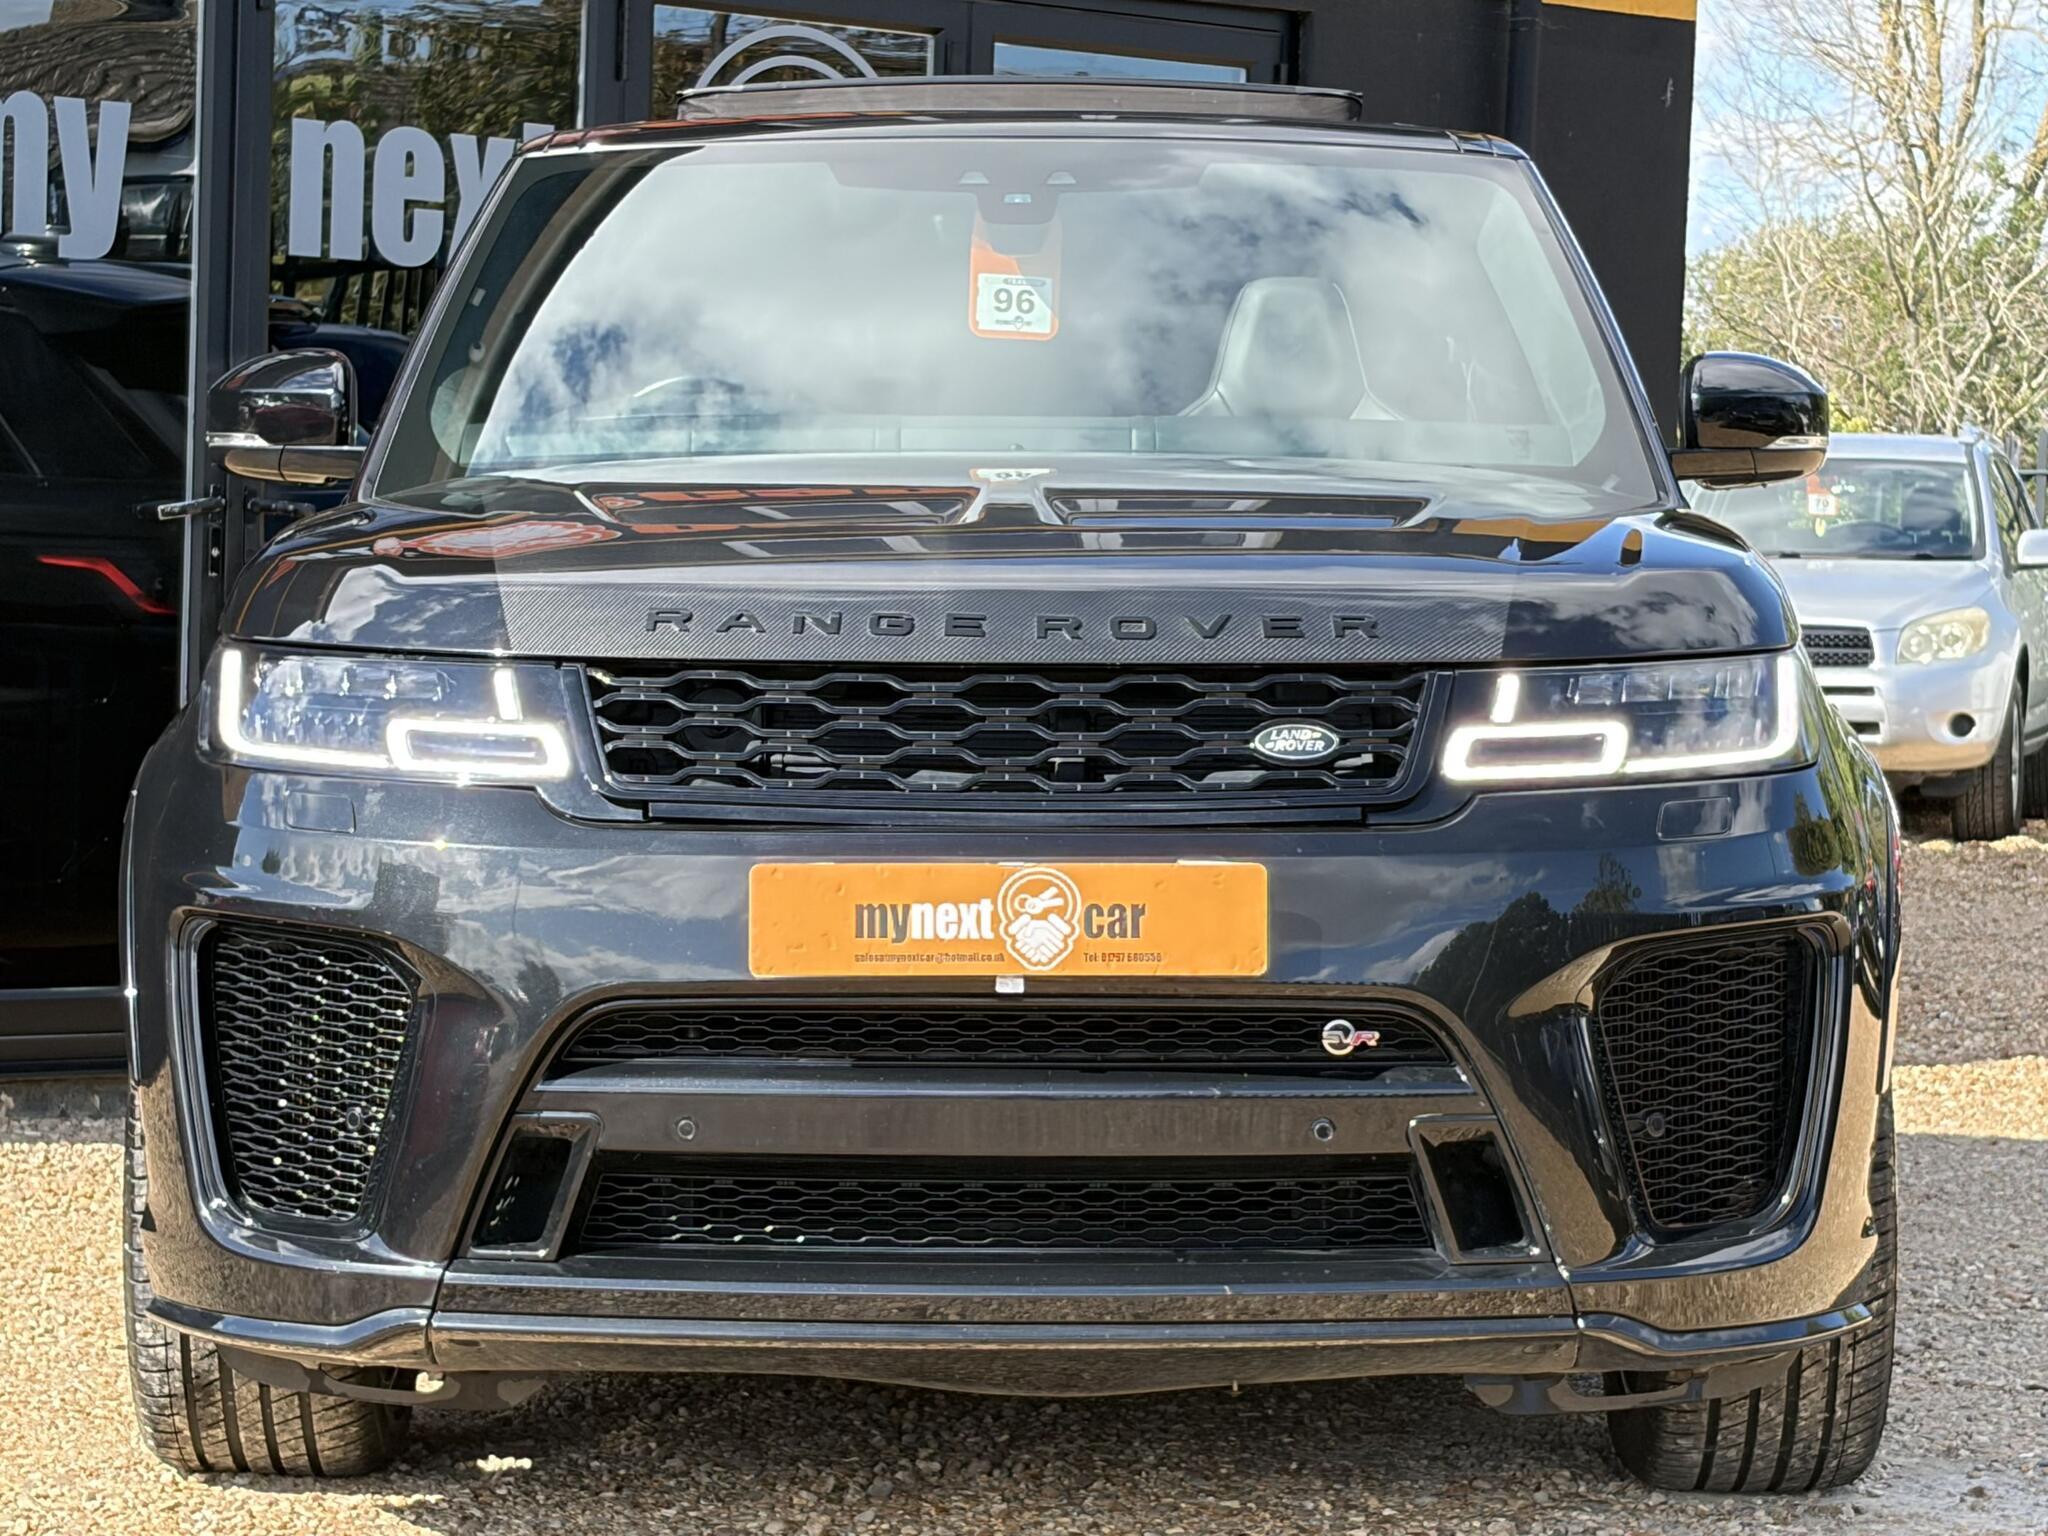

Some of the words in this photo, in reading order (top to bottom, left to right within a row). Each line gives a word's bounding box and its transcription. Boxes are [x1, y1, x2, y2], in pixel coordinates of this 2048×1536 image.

[288, 117, 555, 268] nex
[994, 288, 1035, 314] 96
[645, 608, 987, 638] RANGE
[1034, 613, 1382, 641] ROVER
[1270, 729, 1311, 740] LAND
[1272, 740, 1325, 751] ROVER
[1083, 903, 1147, 938] car
